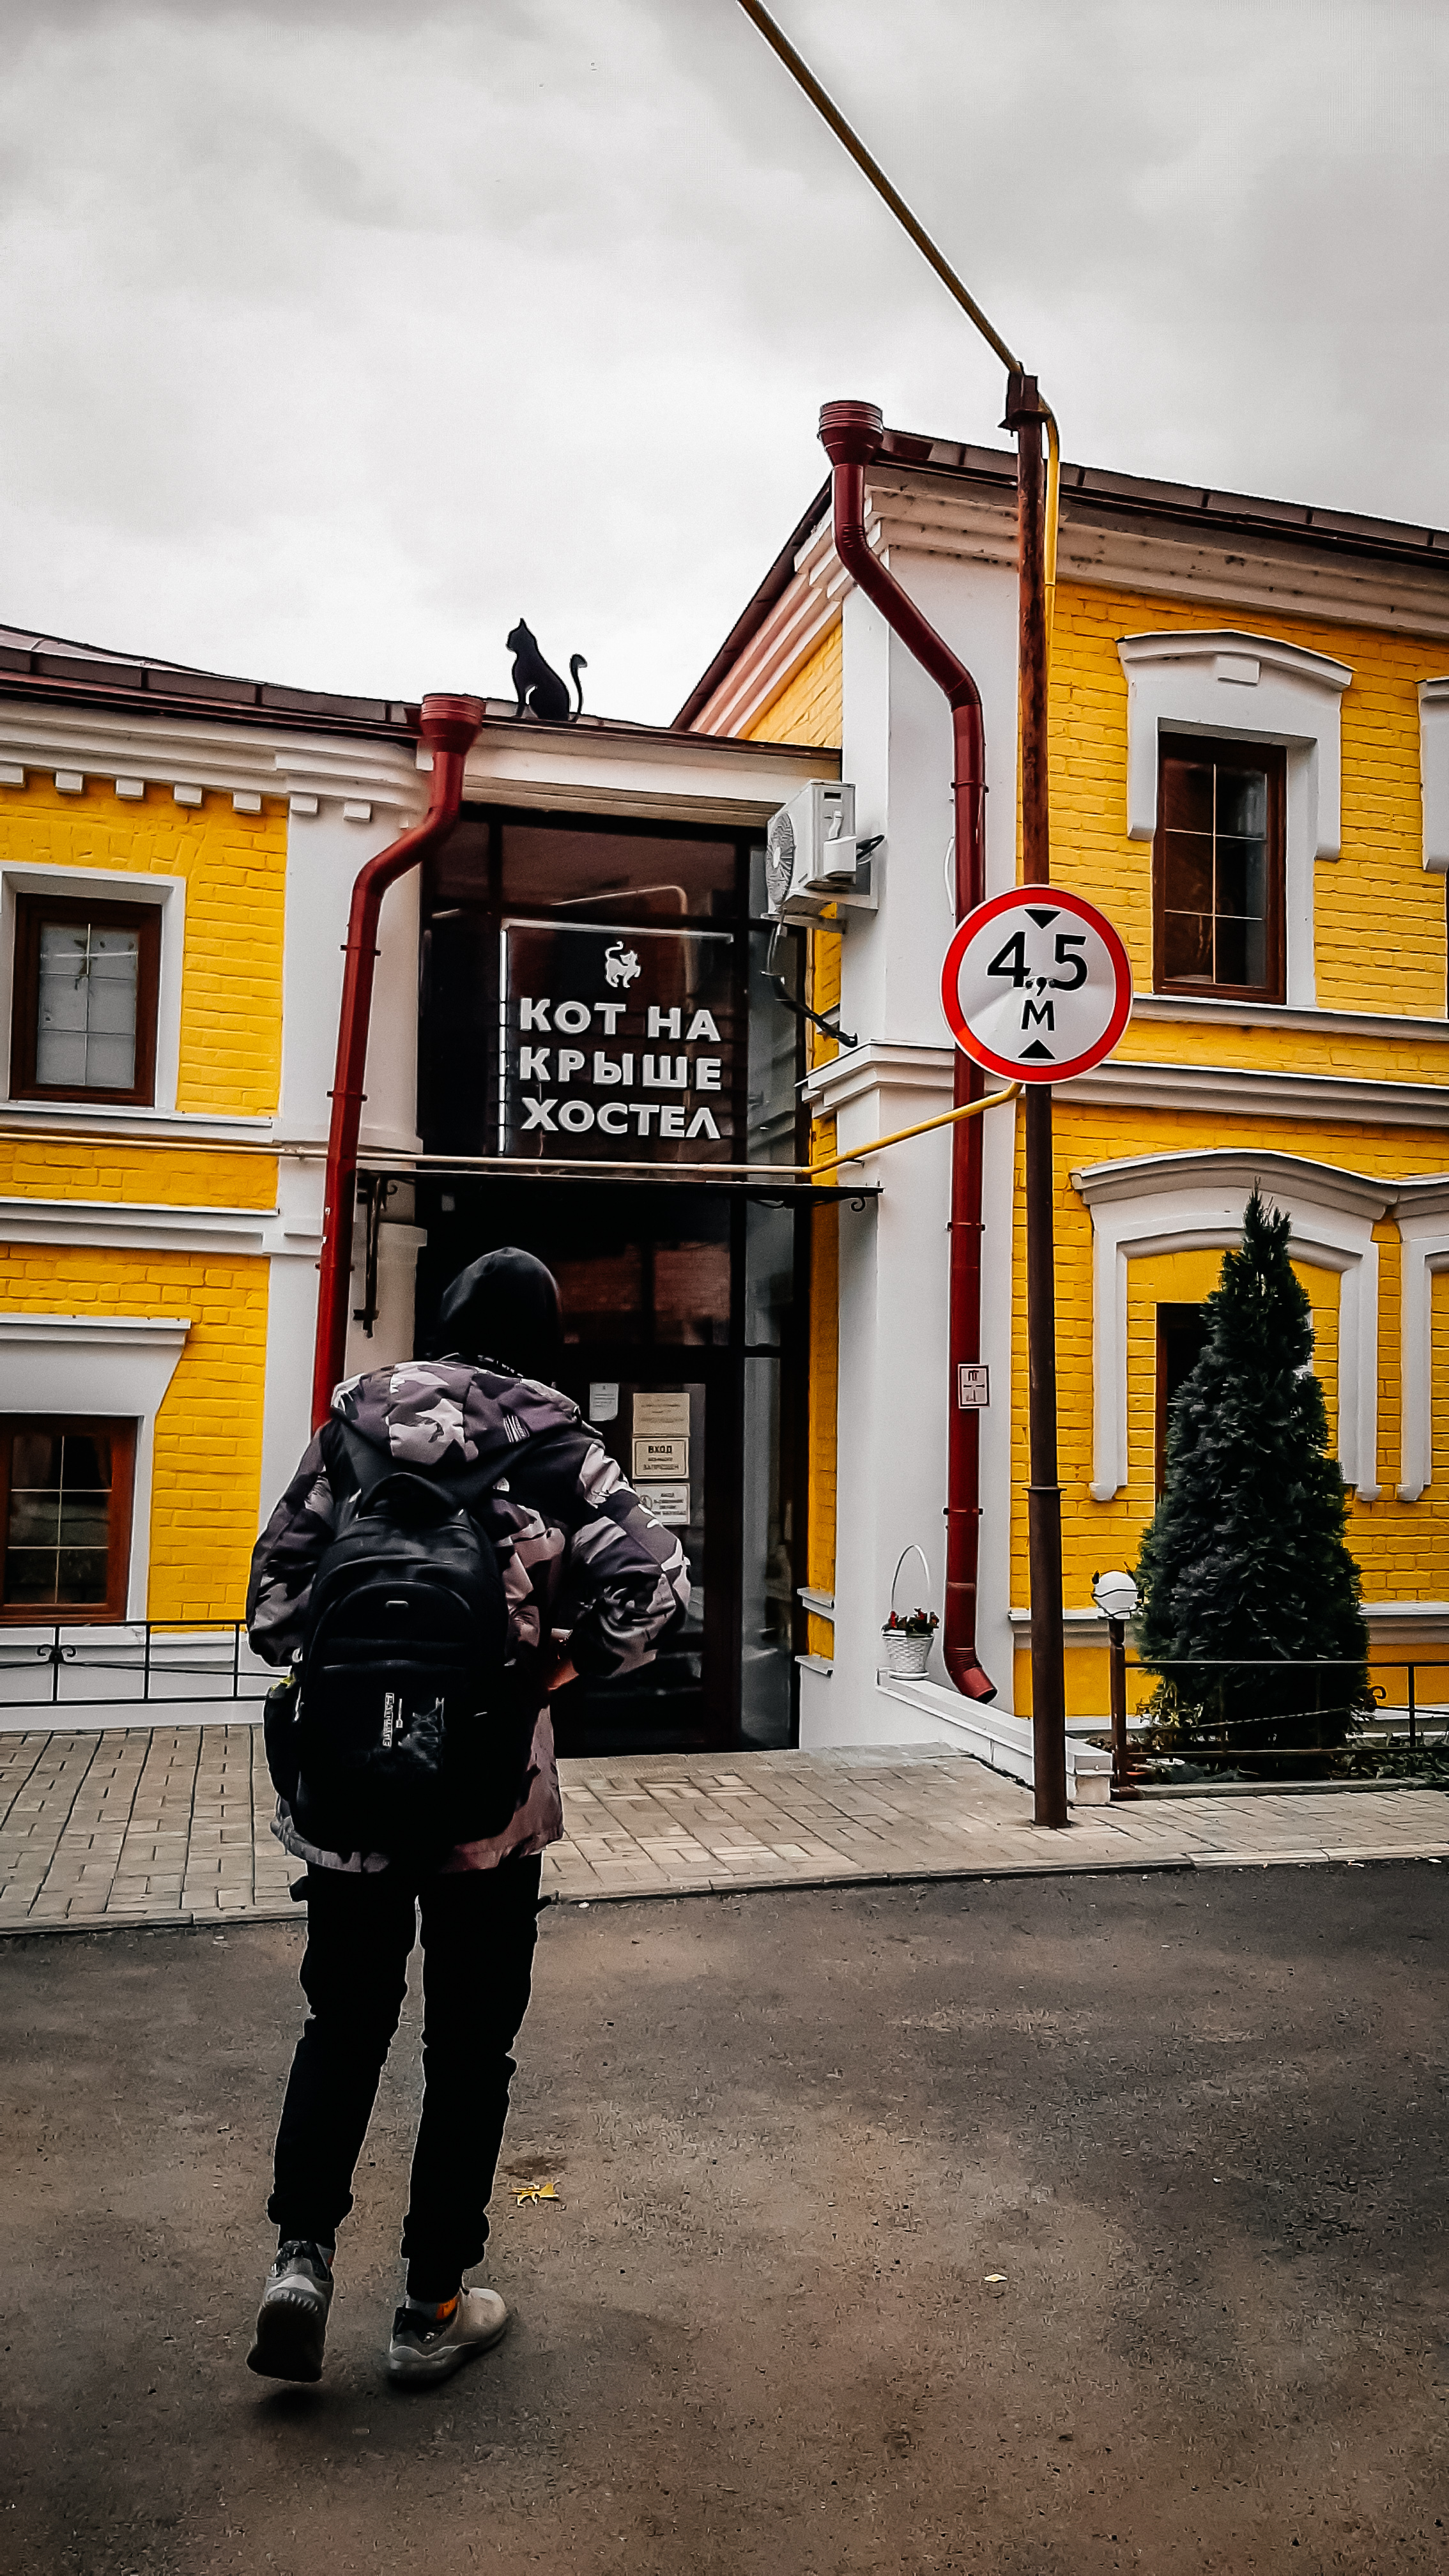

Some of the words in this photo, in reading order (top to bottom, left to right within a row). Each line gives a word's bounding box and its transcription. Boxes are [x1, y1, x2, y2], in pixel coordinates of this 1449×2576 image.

[986, 931, 1088, 996] 4,5
[519, 997, 626, 1035] КОТ
[647, 1006, 721, 1041] НА
[519, 1046, 721, 1091] КРЫШЕ
[520, 1097, 721, 1139] ХОСТЕЛ
[648, 1445, 673, 1453] ВХОД
